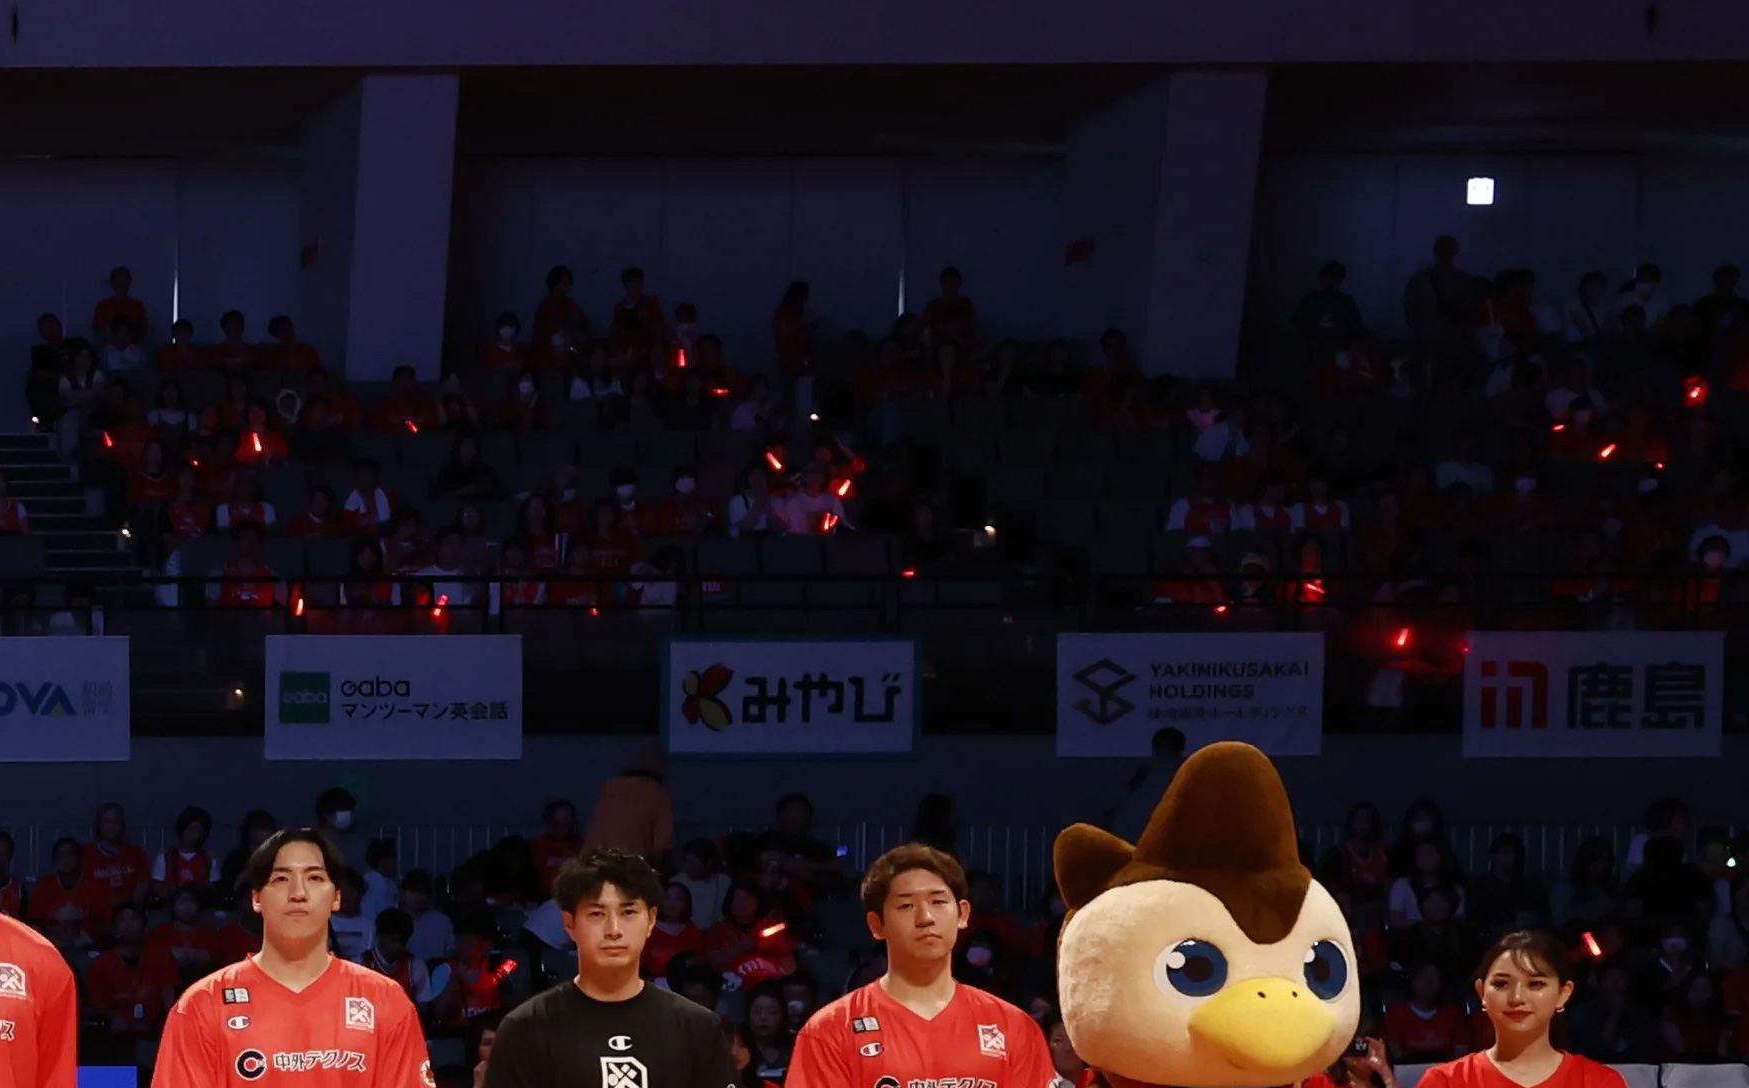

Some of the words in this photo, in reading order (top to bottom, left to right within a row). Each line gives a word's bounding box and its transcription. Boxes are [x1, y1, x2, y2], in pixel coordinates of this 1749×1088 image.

[1150, 661, 1309, 678] YAKINIKUSAKAI
[741, 672, 901, 723] みやび
[1149, 684, 1256, 700] HOLDINGS
[1567, 660, 1707, 729] 鹿島
[341, 701, 509, 720] マンツーマン英会話
[272, 1050, 367, 1073] 中外テクノス
